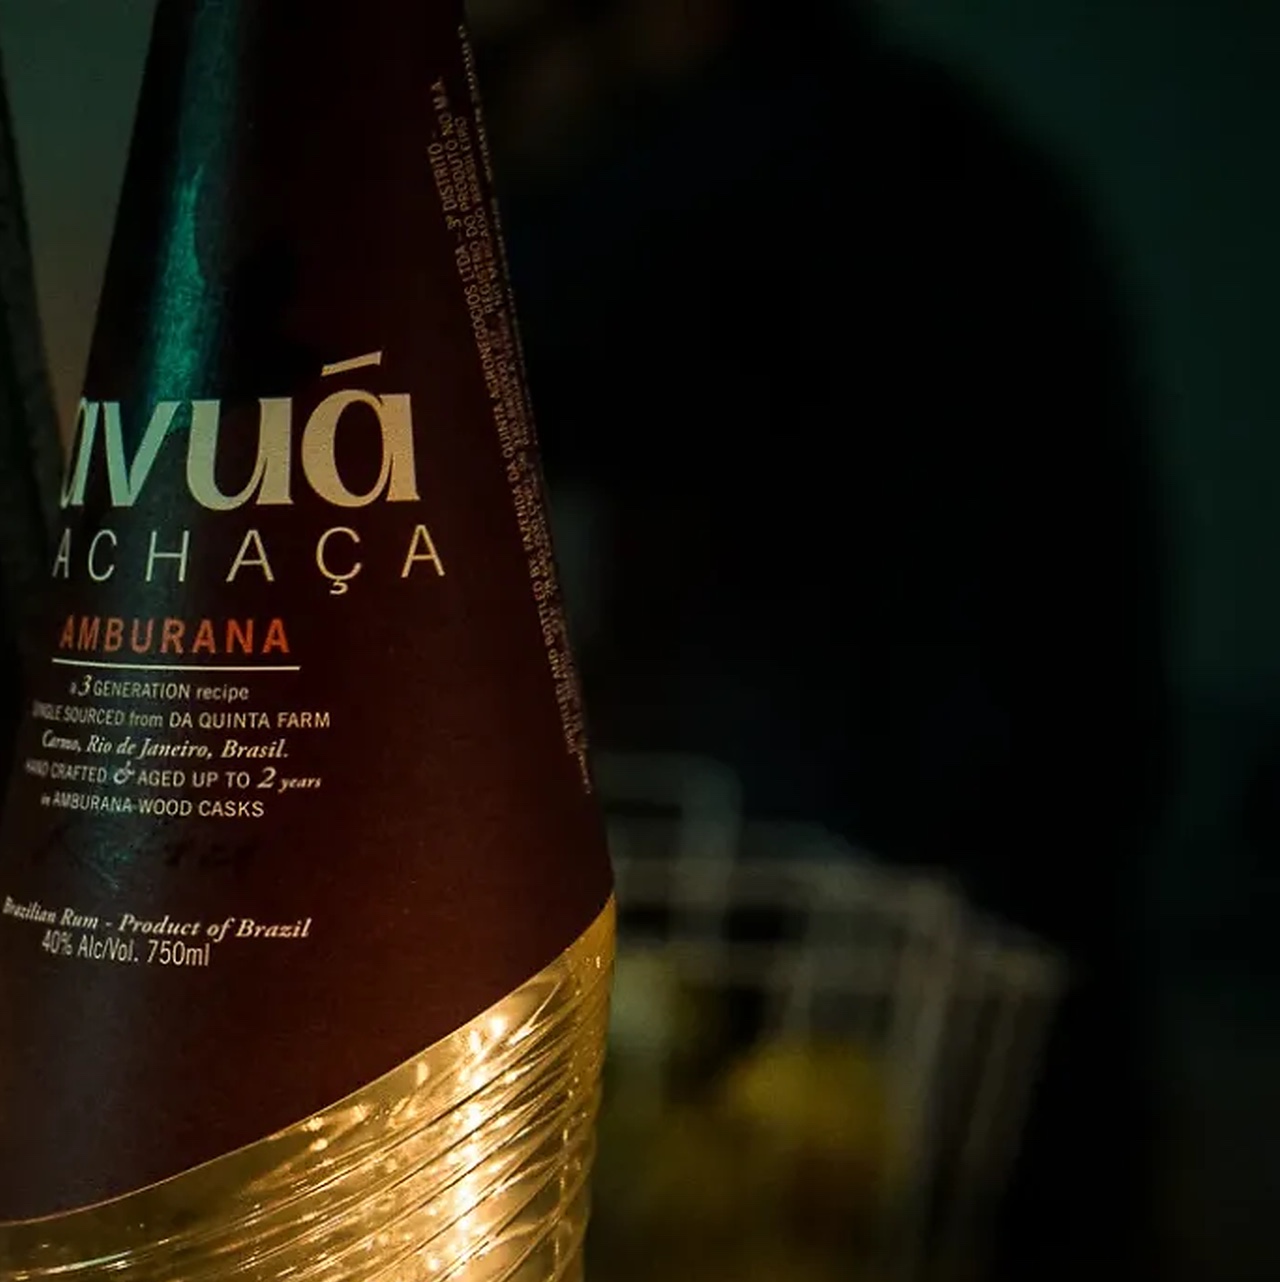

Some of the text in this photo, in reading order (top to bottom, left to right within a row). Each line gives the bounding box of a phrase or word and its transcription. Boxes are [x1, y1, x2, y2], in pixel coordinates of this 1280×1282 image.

[59, 614, 290, 654] AMBURANA
[77, 674, 93, 697] 3
[93, 681, 190, 700] GENERATION
[196, 684, 249, 702] recipe
[64, 705, 125, 726] SOURCED
[128, 711, 164, 728] from
[169, 712, 193, 729] DA
[198, 712, 271, 731] QUINTA
[277, 711, 331, 729] FARM
[86, 734, 113, 754] Rio
[116, 737, 137, 755] de
[137, 738, 213, 761] Janeiro,
[220, 738, 289, 760] Brasil.
[50, 761, 108, 783] CRAFTED
[113, 760, 135, 785] &
[136, 770, 185, 788] AGED
[192, 772, 217, 788] UP
[226, 772, 251, 789] TO
[256, 767, 277, 790] 2
[278, 776, 322, 792] years
[198, 800, 264, 818] CASKS
[60, 907, 99, 930] Rum
[118, 913, 200, 937] Product
[207, 917, 236, 944] of
[235, 917, 312, 939] Brazil
[41, 929, 210, 967] 40% Alc/Vol. 750ml
